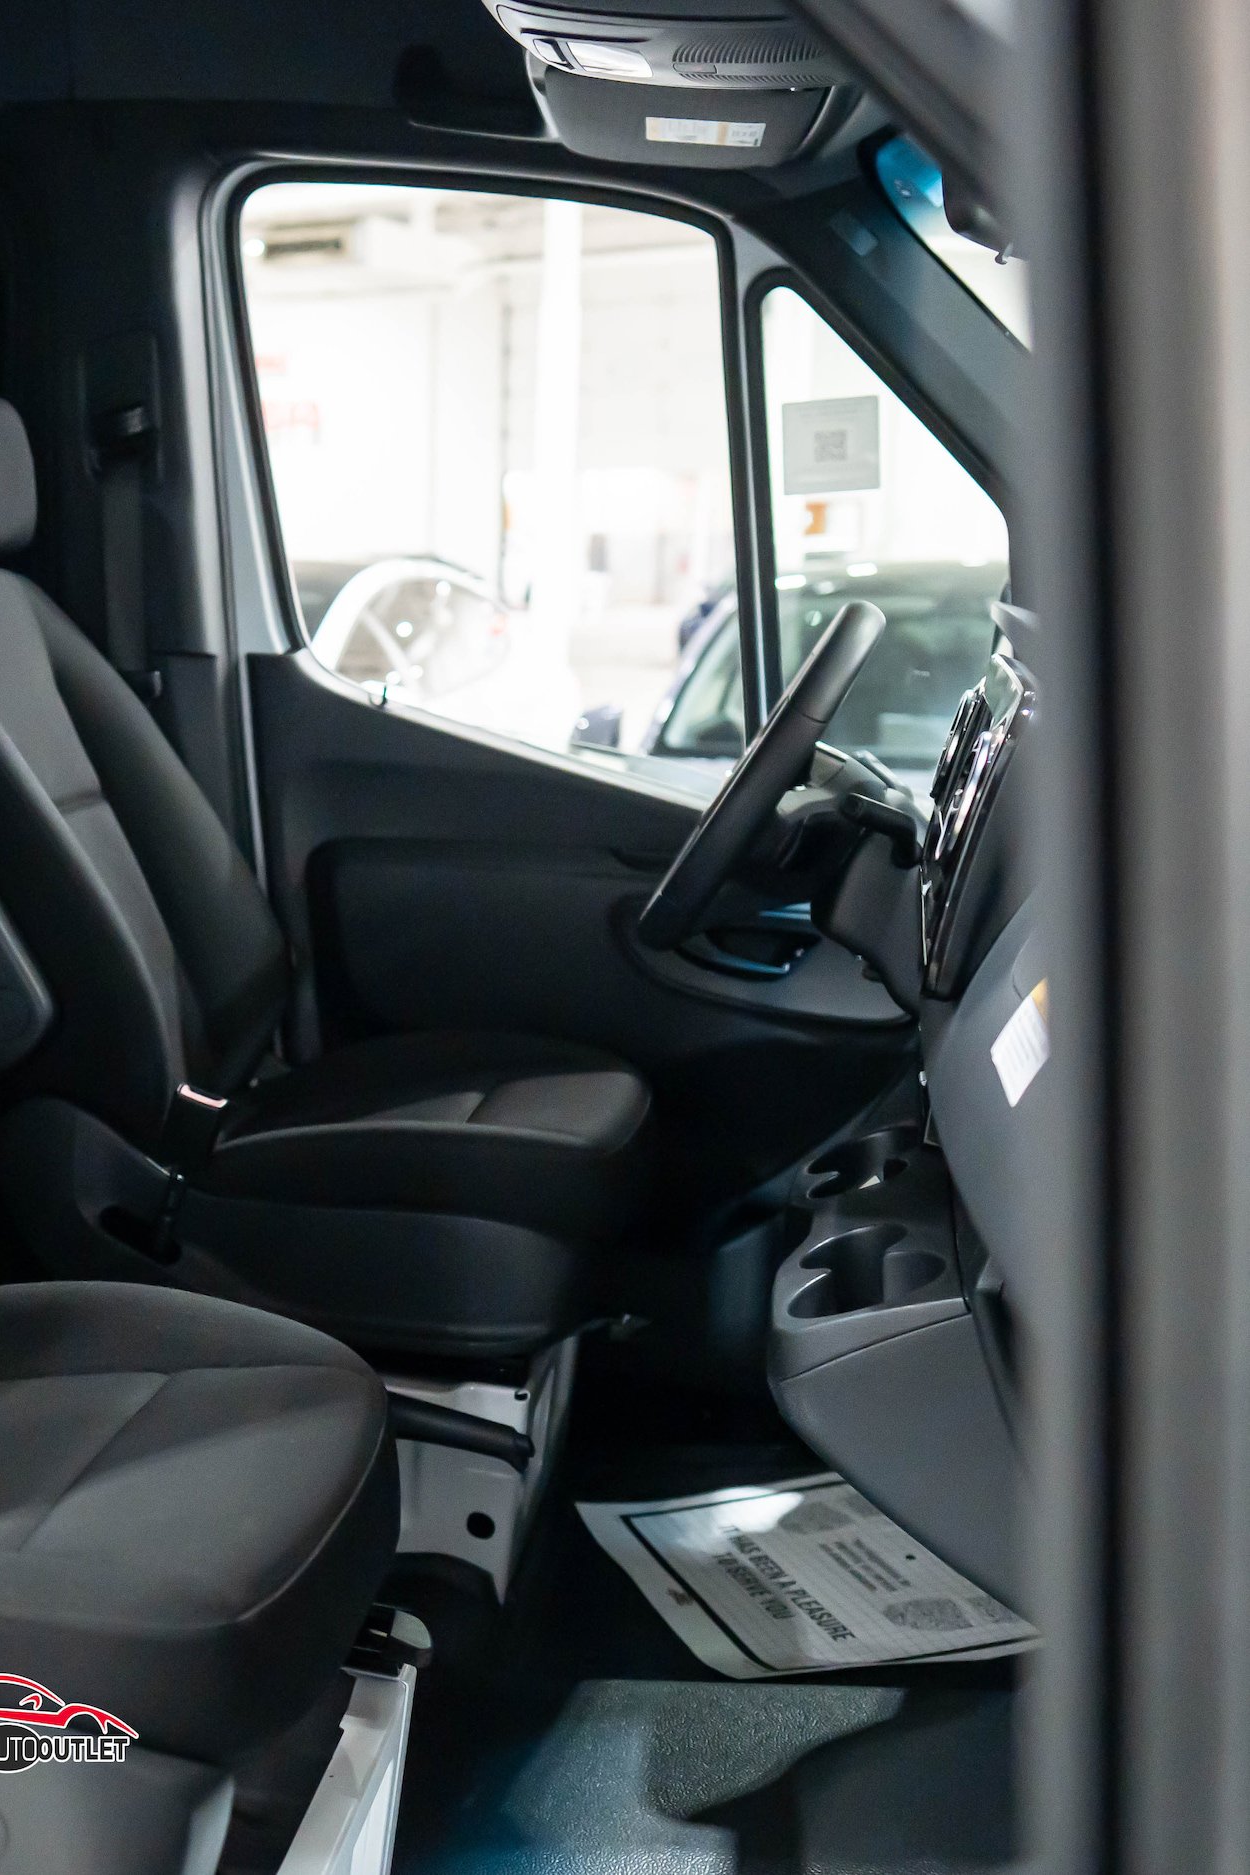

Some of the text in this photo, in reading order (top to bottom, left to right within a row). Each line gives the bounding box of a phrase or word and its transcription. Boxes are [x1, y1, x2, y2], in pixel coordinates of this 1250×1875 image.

[729, 1534, 761, 1554] HAS
[748, 1555, 787, 1579] BEEN
[712, 1552, 738, 1566] TO
[760, 1597, 796, 1620] YOU
[775, 1579, 796, 1589] A
[785, 1587, 856, 1642] PLEASURE
